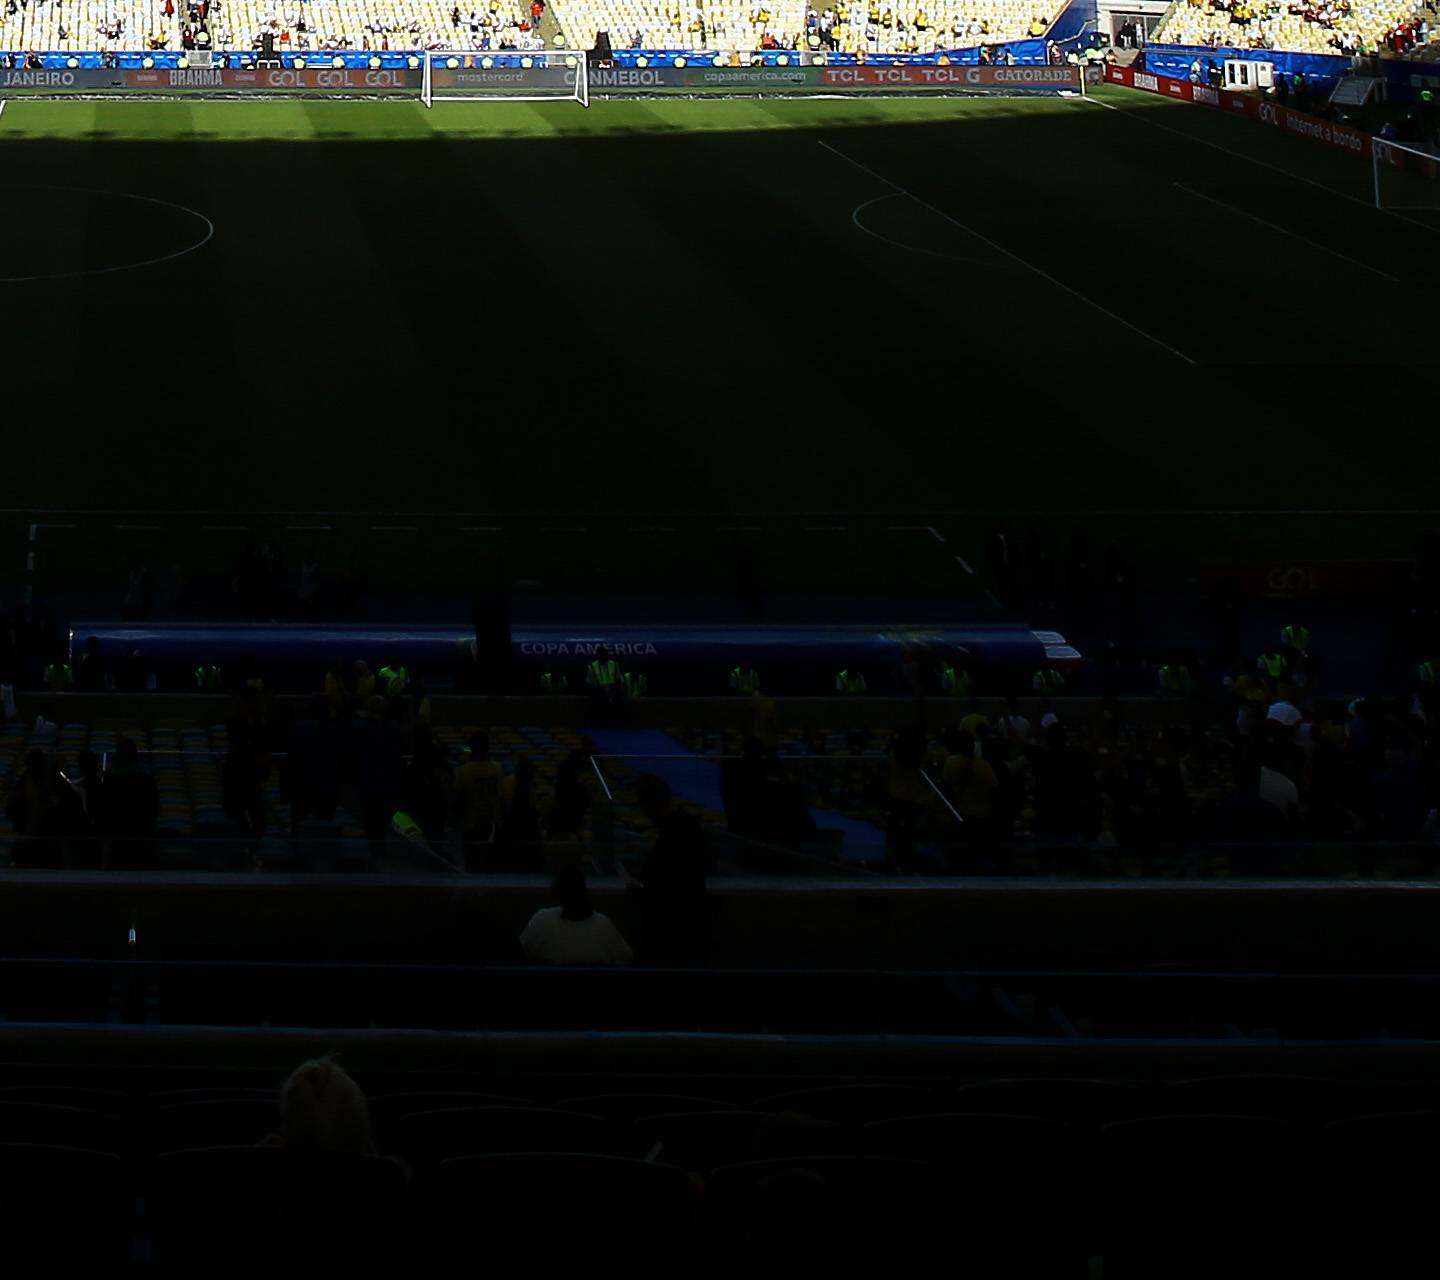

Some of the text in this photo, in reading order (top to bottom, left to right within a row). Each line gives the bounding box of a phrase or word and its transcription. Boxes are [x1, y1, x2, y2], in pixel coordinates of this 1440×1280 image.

[3, 72, 74, 85] JANEIRO
[170, 69, 222, 85] BRAHMA
[270, 70, 402, 87] GOL GOL GOL
[704, 70, 806, 82] copaamerica.com
[828, 70, 959, 81] TCL TCL TCL
[994, 69, 1071, 81] GATORADE
[520, 641, 570, 656] COPA
